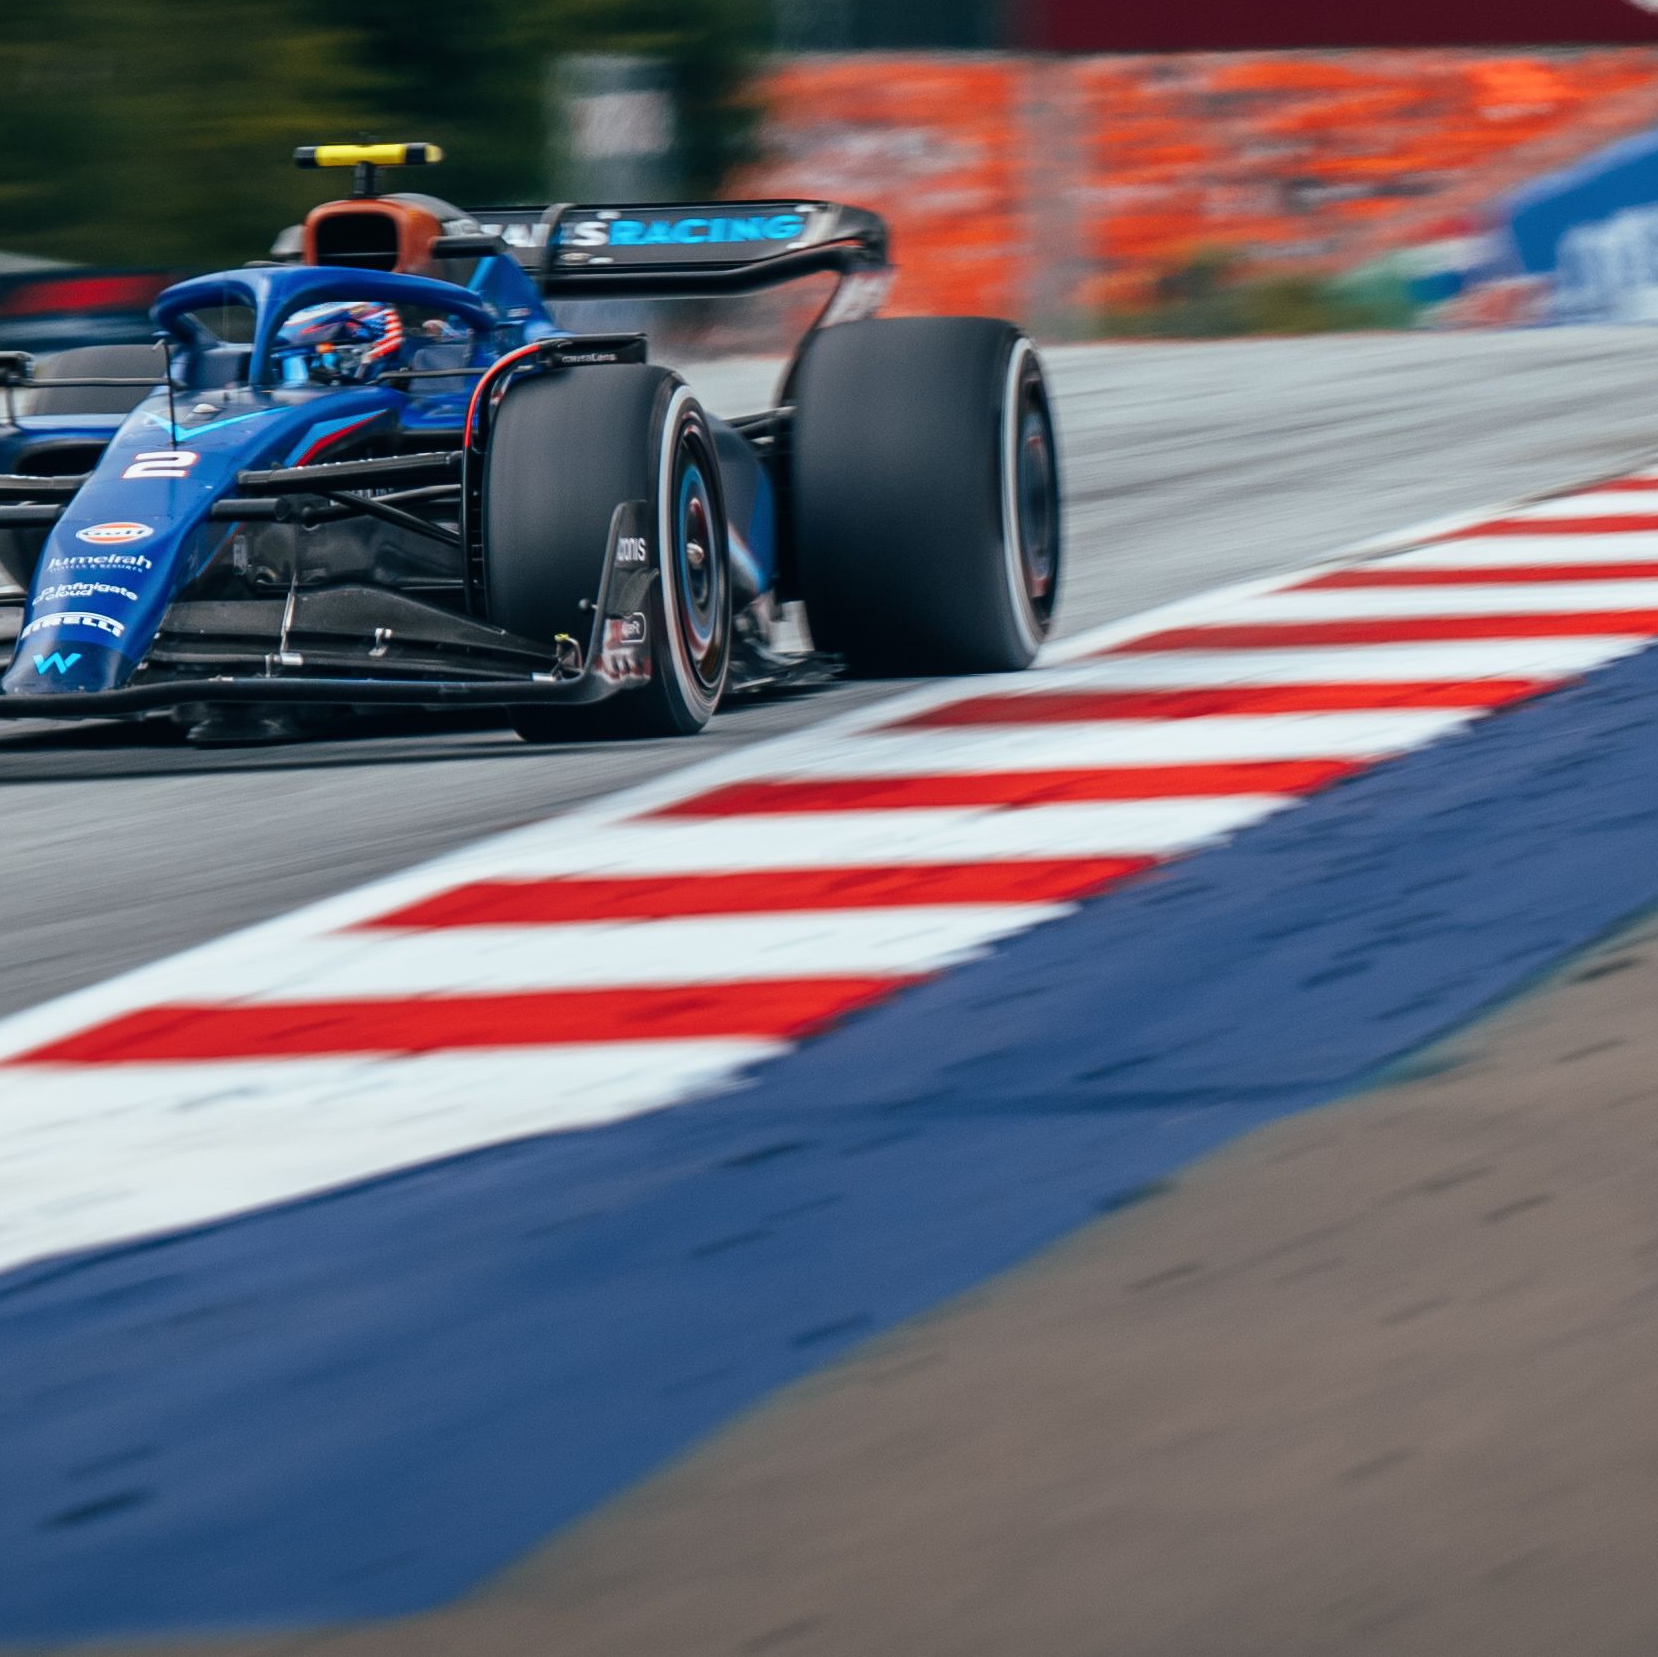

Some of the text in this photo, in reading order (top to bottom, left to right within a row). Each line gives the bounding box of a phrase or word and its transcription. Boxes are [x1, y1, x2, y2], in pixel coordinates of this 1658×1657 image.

[609, 215, 804, 246] RACING
[120, 450, 199, 479] 2
[45, 586, 93, 601] cloud
[56, 582, 138, 601] infinigate
[21, 611, 125, 639] PIRELLI
